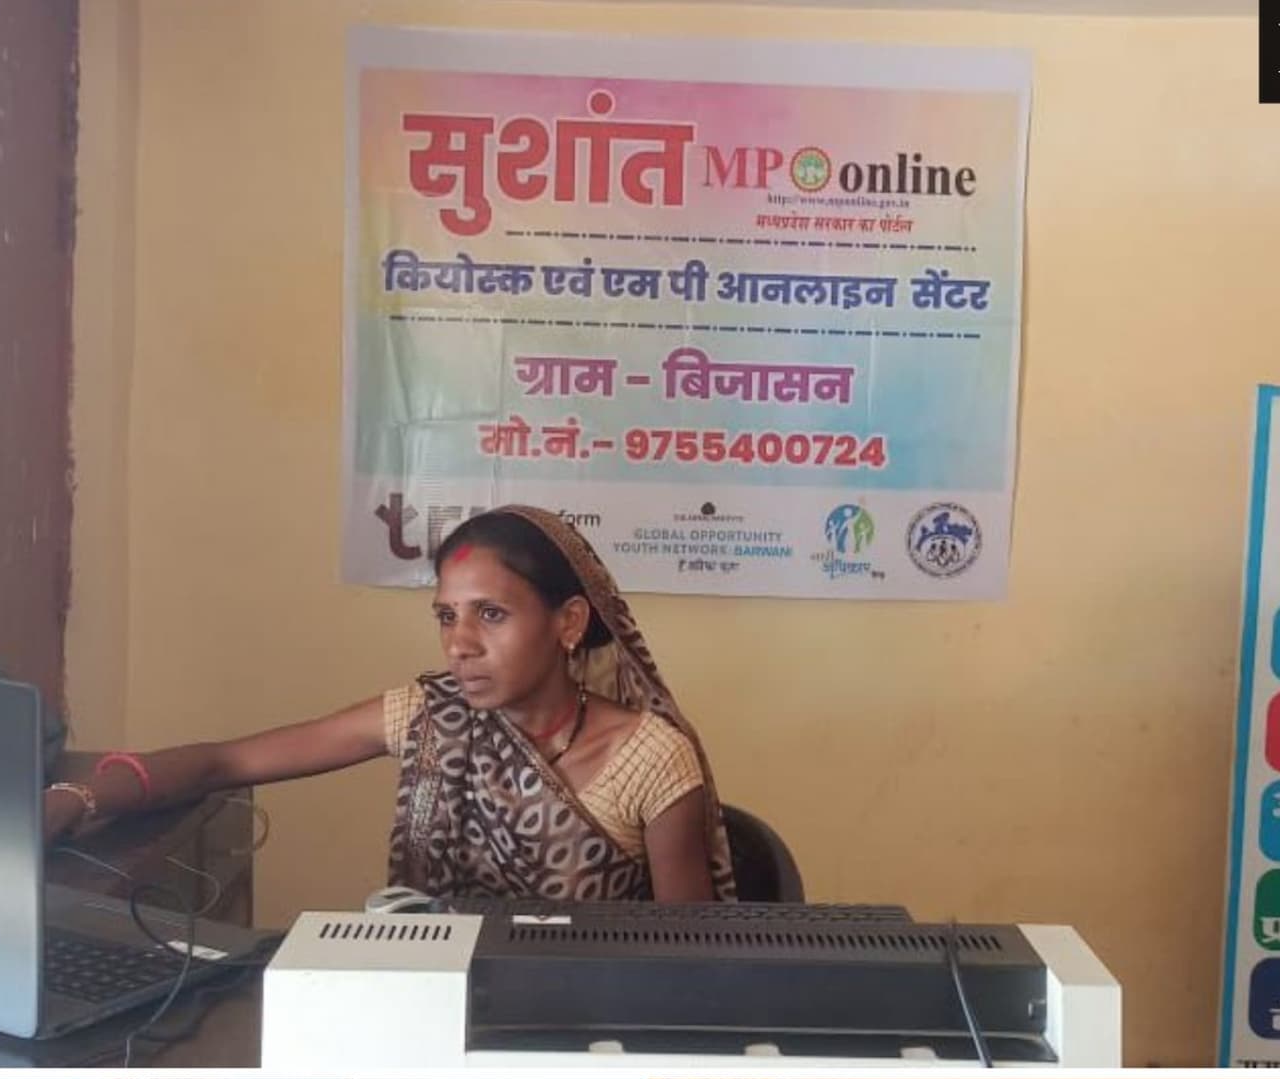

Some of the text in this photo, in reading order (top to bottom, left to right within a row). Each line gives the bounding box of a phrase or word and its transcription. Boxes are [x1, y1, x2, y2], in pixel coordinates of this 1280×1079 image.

[402, 92, 695, 235] सुशांत
[703, 145, 977, 197] MP online
[383, 249, 992, 312] कियोस्क एवं एम पी आनलाइन सेंटर
[515, 356, 618, 398] ग्राम
[662, 346, 854, 405] बिजासन
[624, 428, 886, 467] 9755400724
[613, 542, 659, 554] YOUTH
[634, 528, 783, 543] GLOBAL OPPORTUNITY
